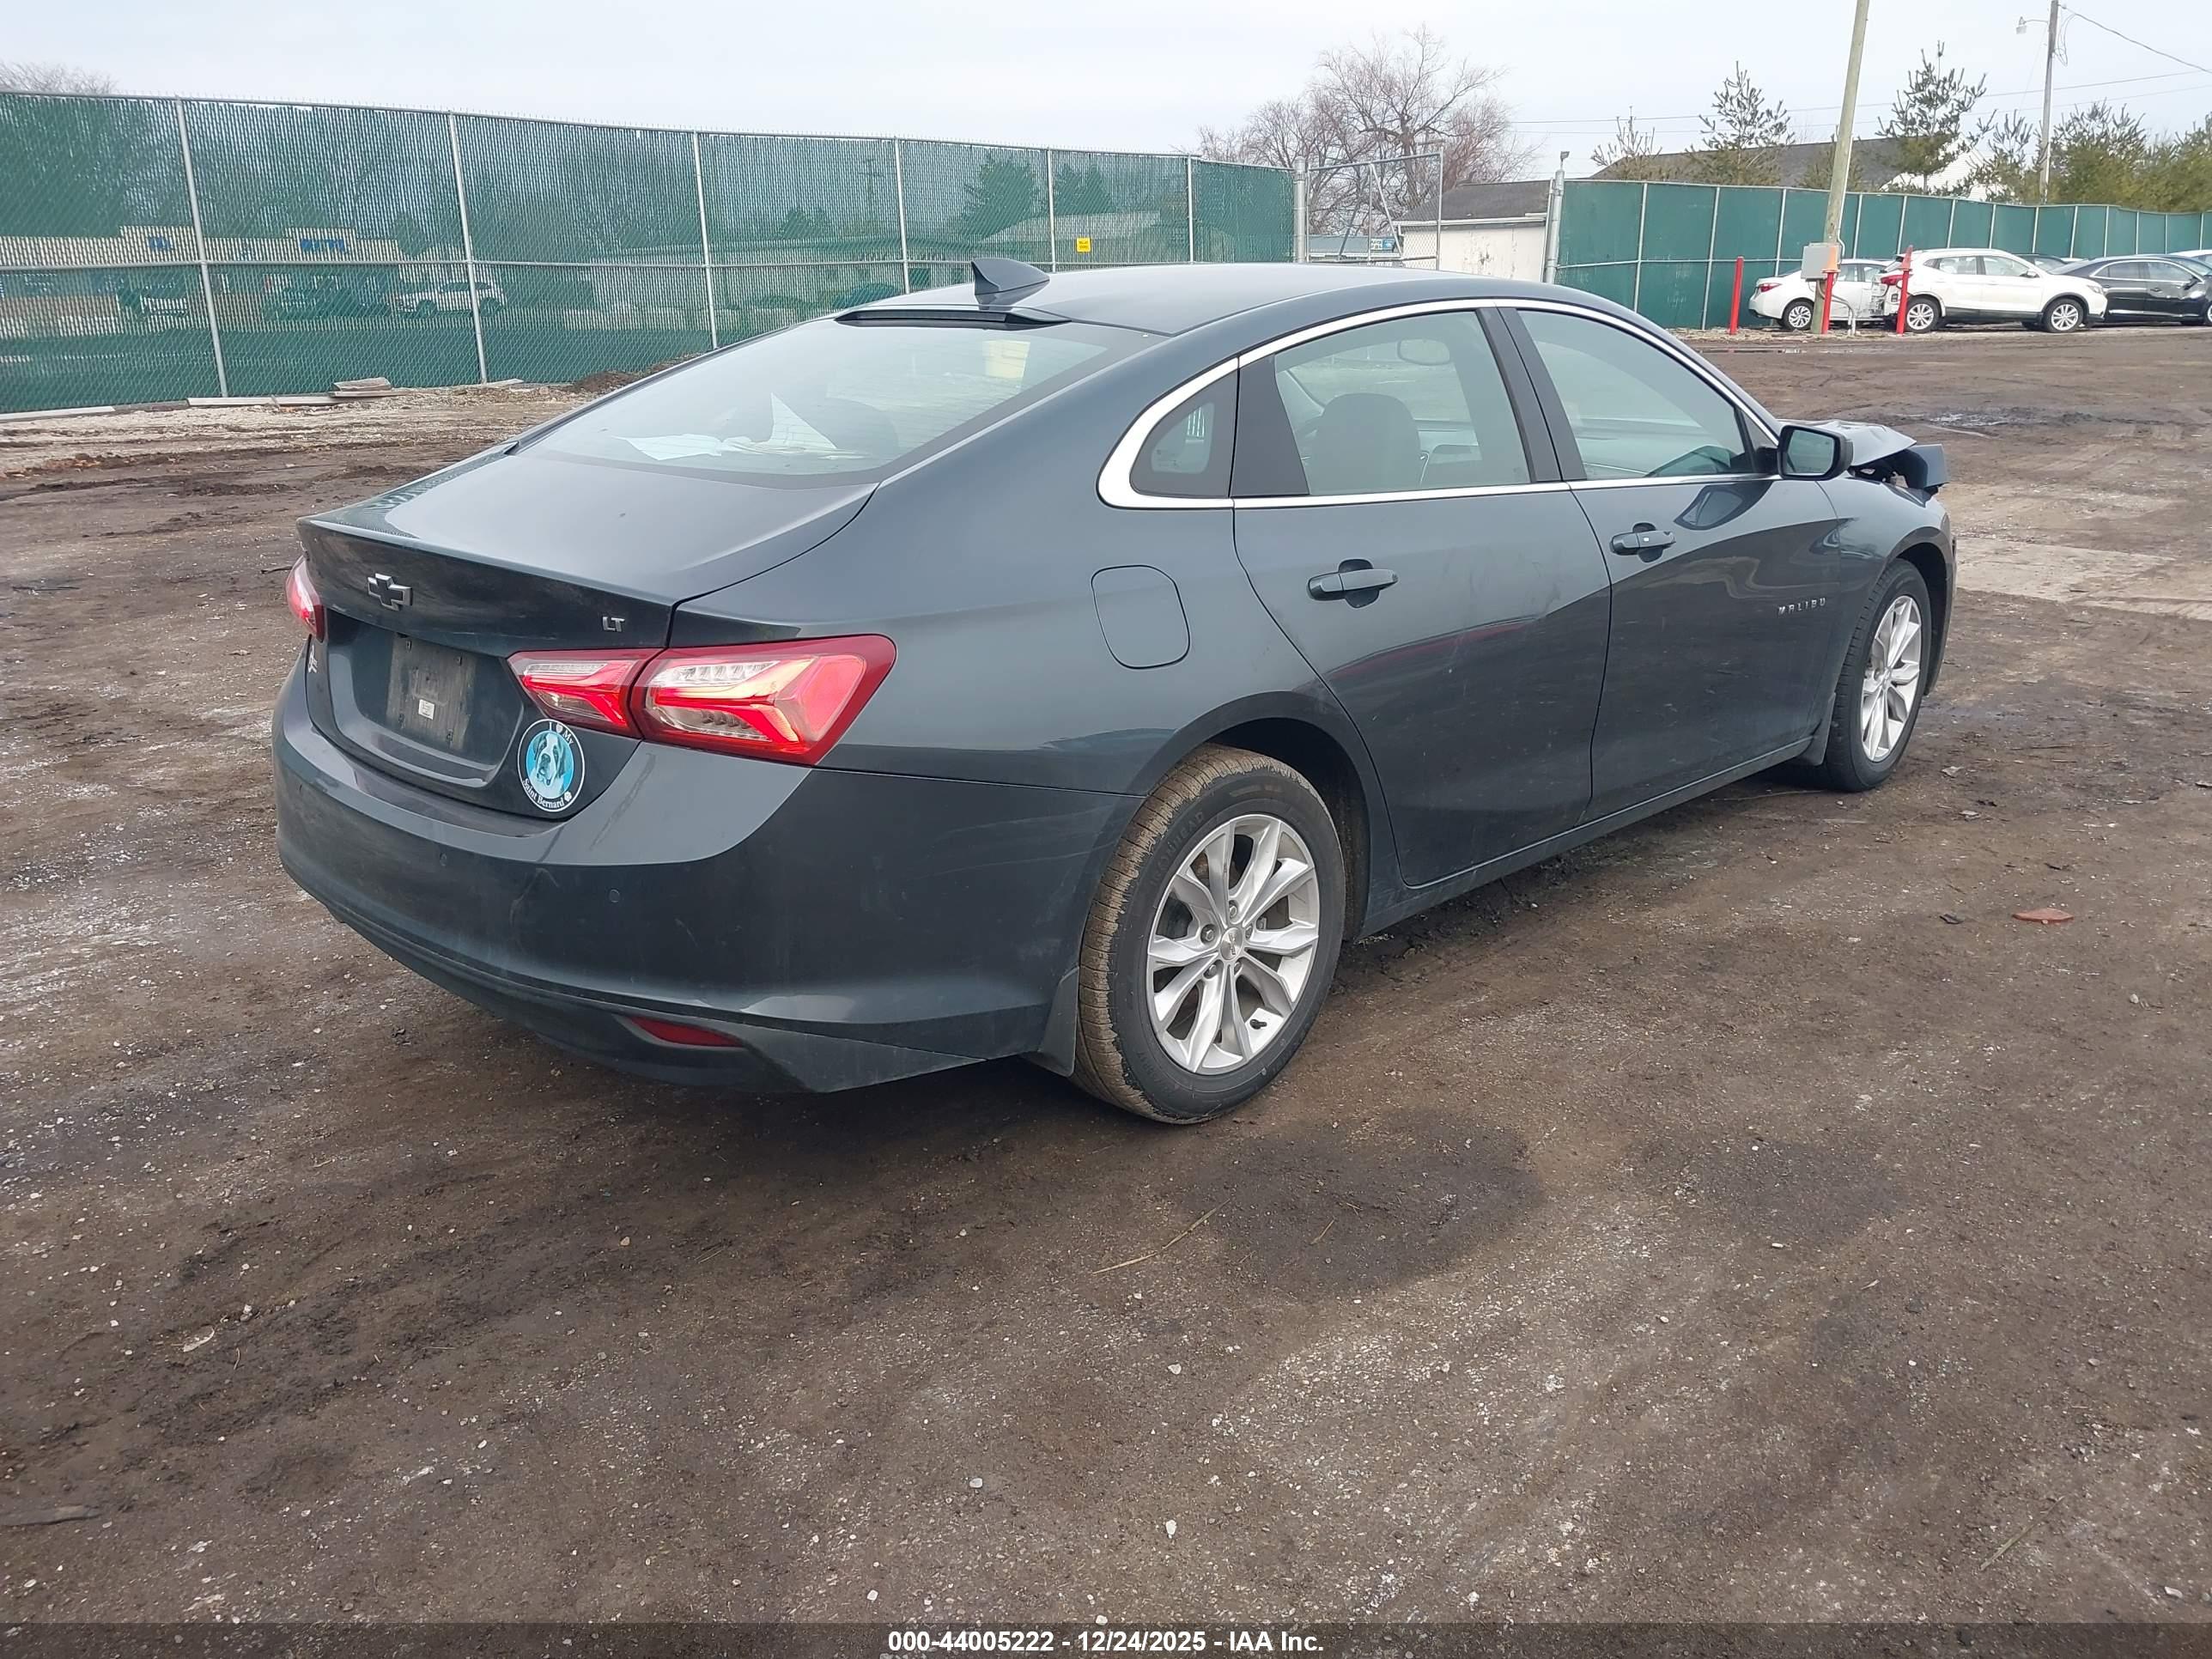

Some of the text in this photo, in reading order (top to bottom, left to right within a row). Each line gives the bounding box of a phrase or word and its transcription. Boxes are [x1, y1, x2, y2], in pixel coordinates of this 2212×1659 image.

[1778, 597, 1826, 616] MALIBU
[602, 616, 626, 632] LT
[562, 730, 574, 745] My
[523, 778, 565, 809] Saint Bernard
